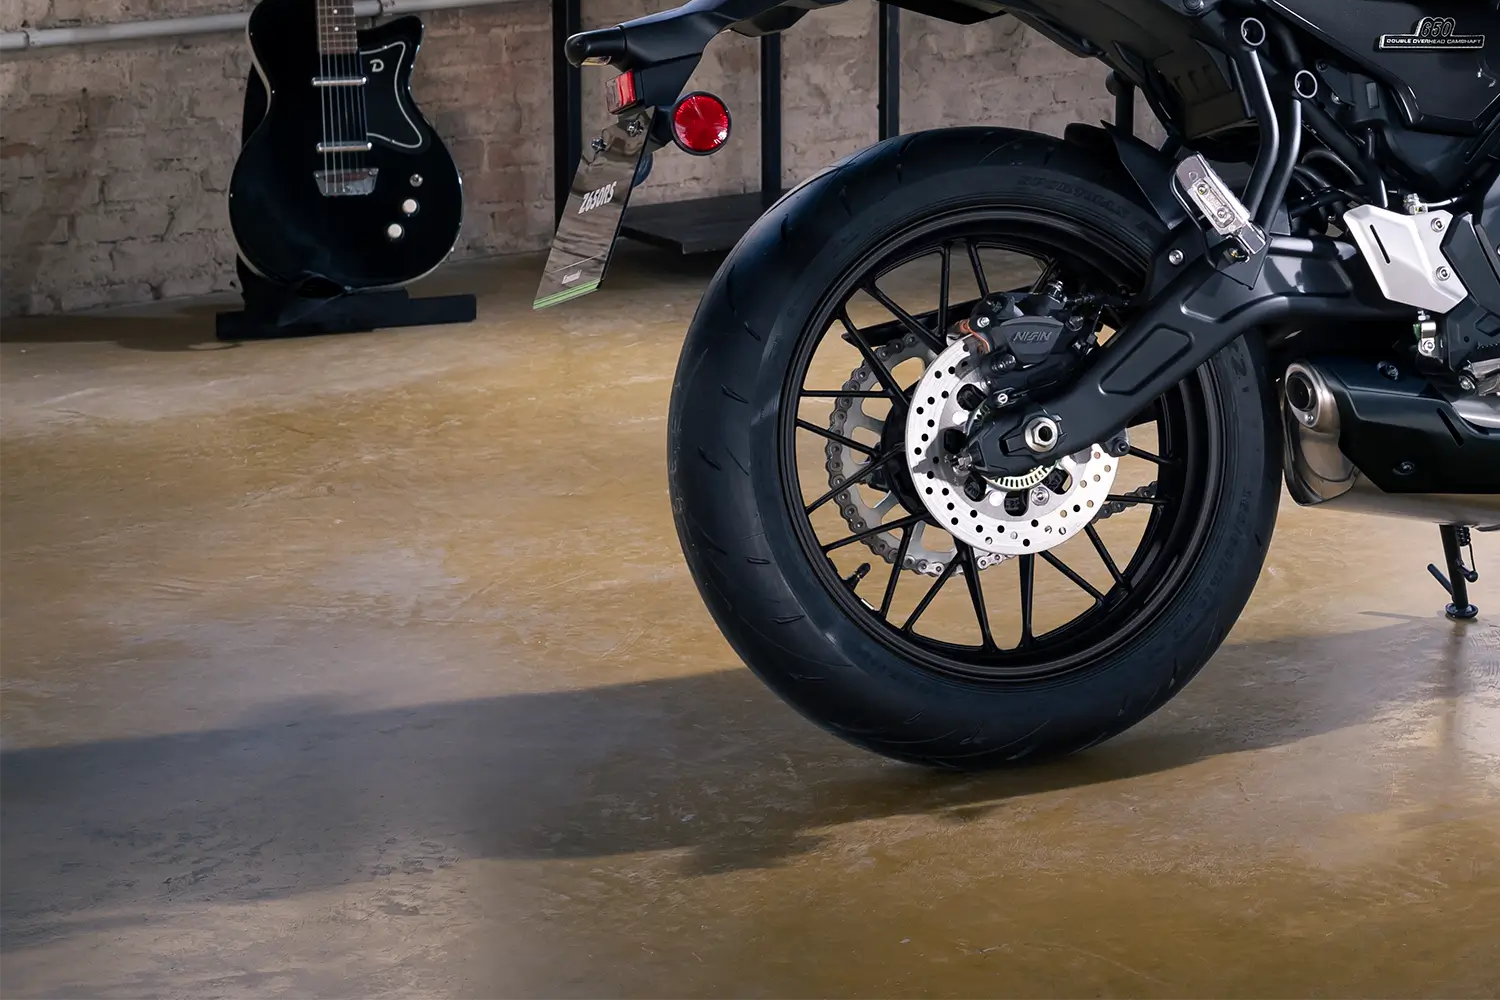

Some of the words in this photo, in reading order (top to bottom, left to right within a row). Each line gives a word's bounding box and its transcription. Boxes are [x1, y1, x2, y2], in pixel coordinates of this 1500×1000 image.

[1420, 22, 1452, 37] 650
[369, 58, 385, 73] D
[578, 180, 617, 215] Z650RS
[1012, 330, 1053, 343] NISSIN
